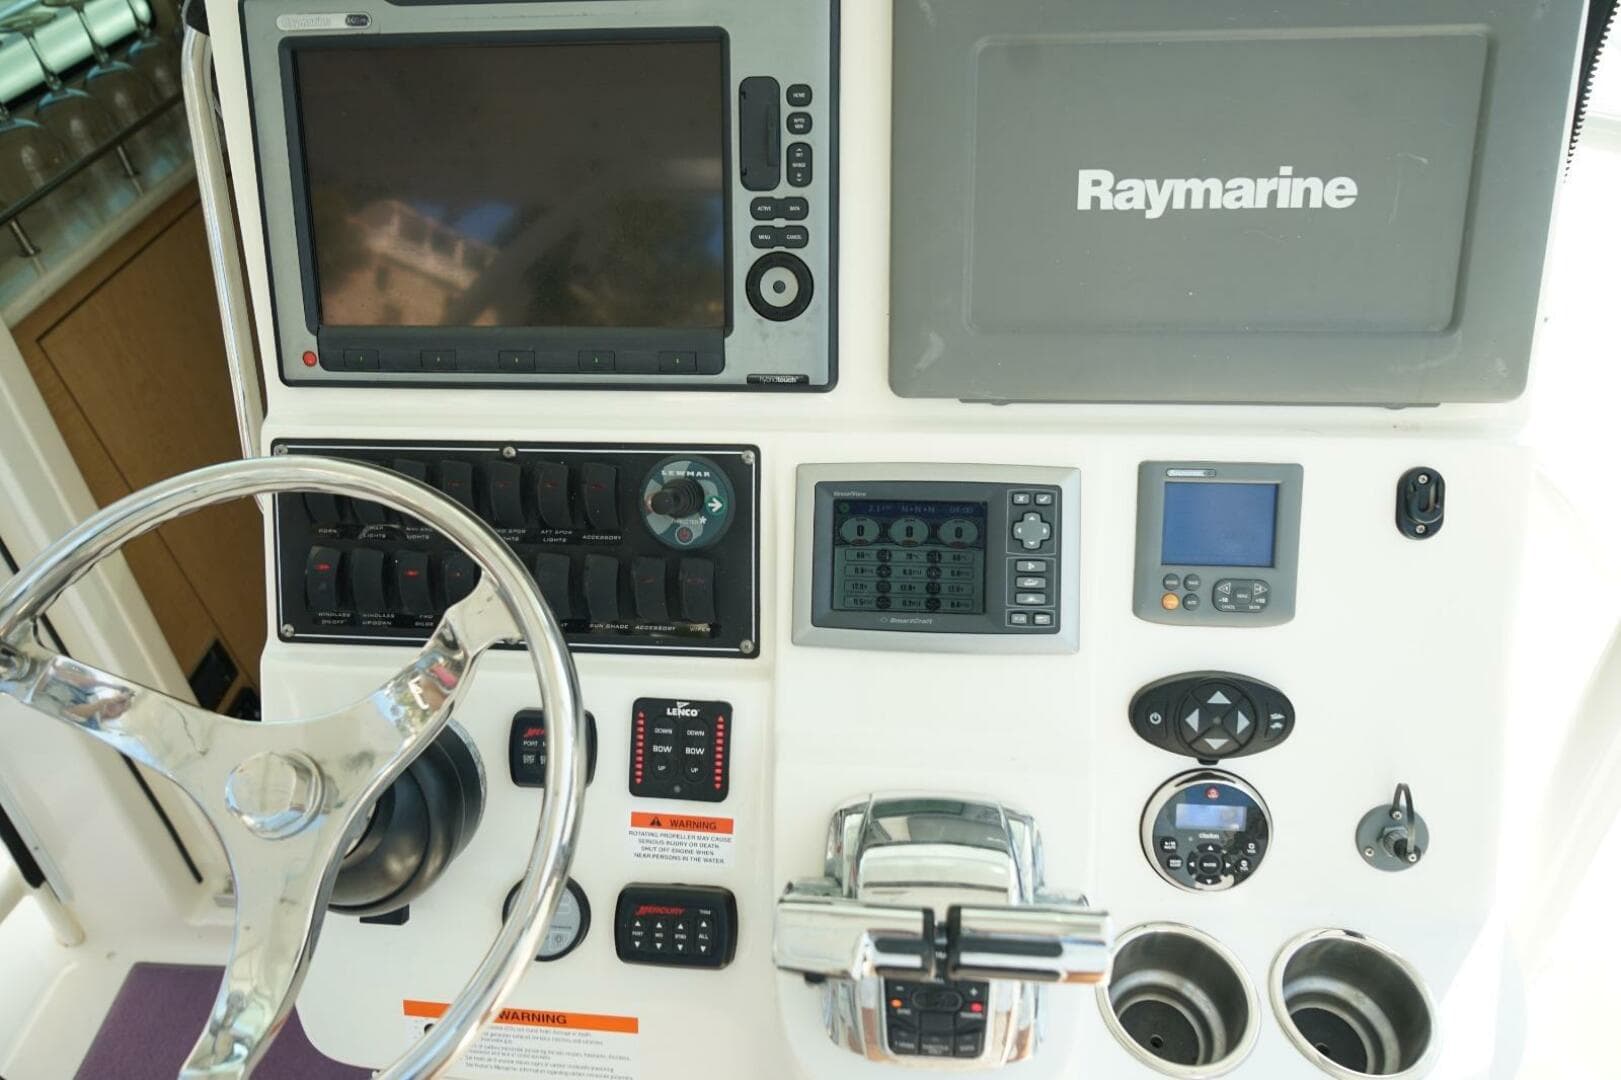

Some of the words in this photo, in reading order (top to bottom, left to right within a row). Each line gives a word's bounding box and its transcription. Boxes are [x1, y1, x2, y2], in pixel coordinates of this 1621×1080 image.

[1077, 165, 1359, 219] Raymarine
[661, 470, 710, 478] LEWMAR
[666, 706, 699, 717] LENCO
[654, 727, 673, 735] DOWN
[652, 744, 673, 753] BOW
[685, 746, 705, 755] BOW
[669, 819, 718, 831] WARNING
[659, 832, 697, 840] PROPELLER
[696, 834, 710, 842] MAY
[651, 853, 681, 861] PERSONS
[698, 932, 709, 940] ALL
[498, 1010, 567, 1024] WARNING
